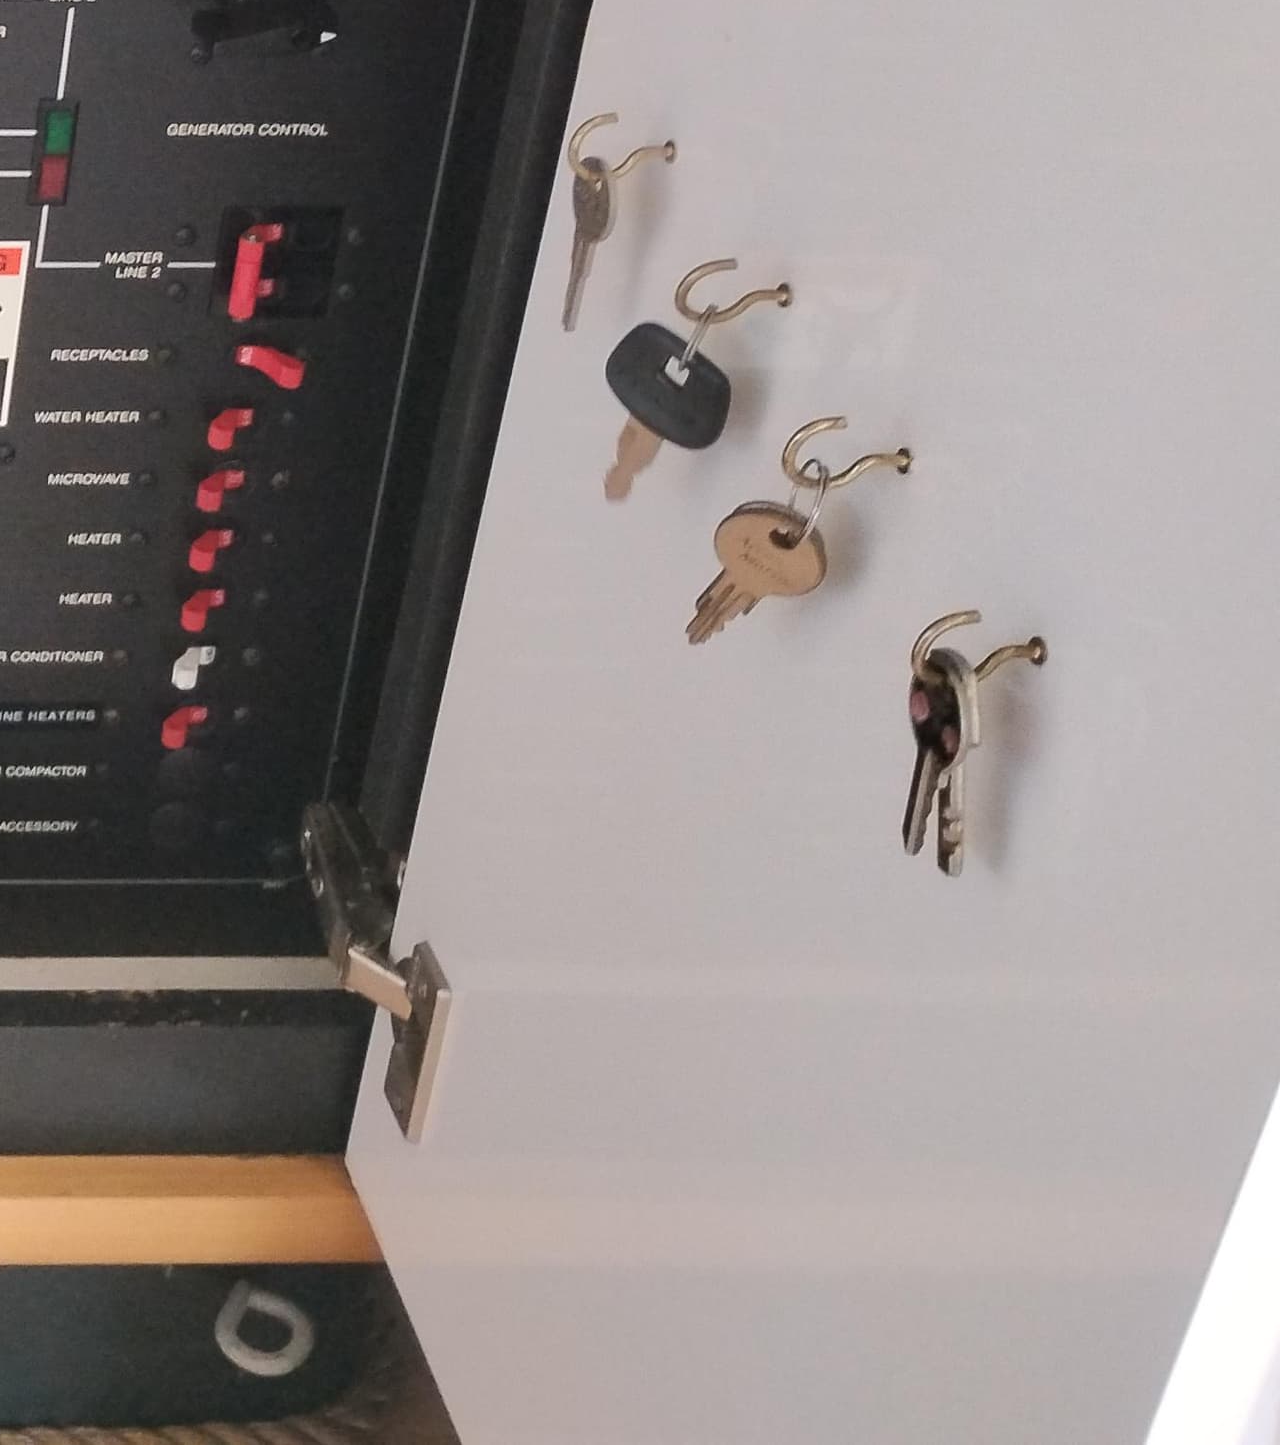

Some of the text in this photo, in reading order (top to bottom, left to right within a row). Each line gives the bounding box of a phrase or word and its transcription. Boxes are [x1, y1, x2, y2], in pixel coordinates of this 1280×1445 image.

[167, 124, 328, 136] GENERATOR CONTROL
[105, 252, 163, 264] MASTER
[116, 266, 147, 278] LINE
[35, 411, 139, 423] WATER HEATER
[68, 533, 121, 545] HEATER
[28, 710, 95, 721] HEATERS
